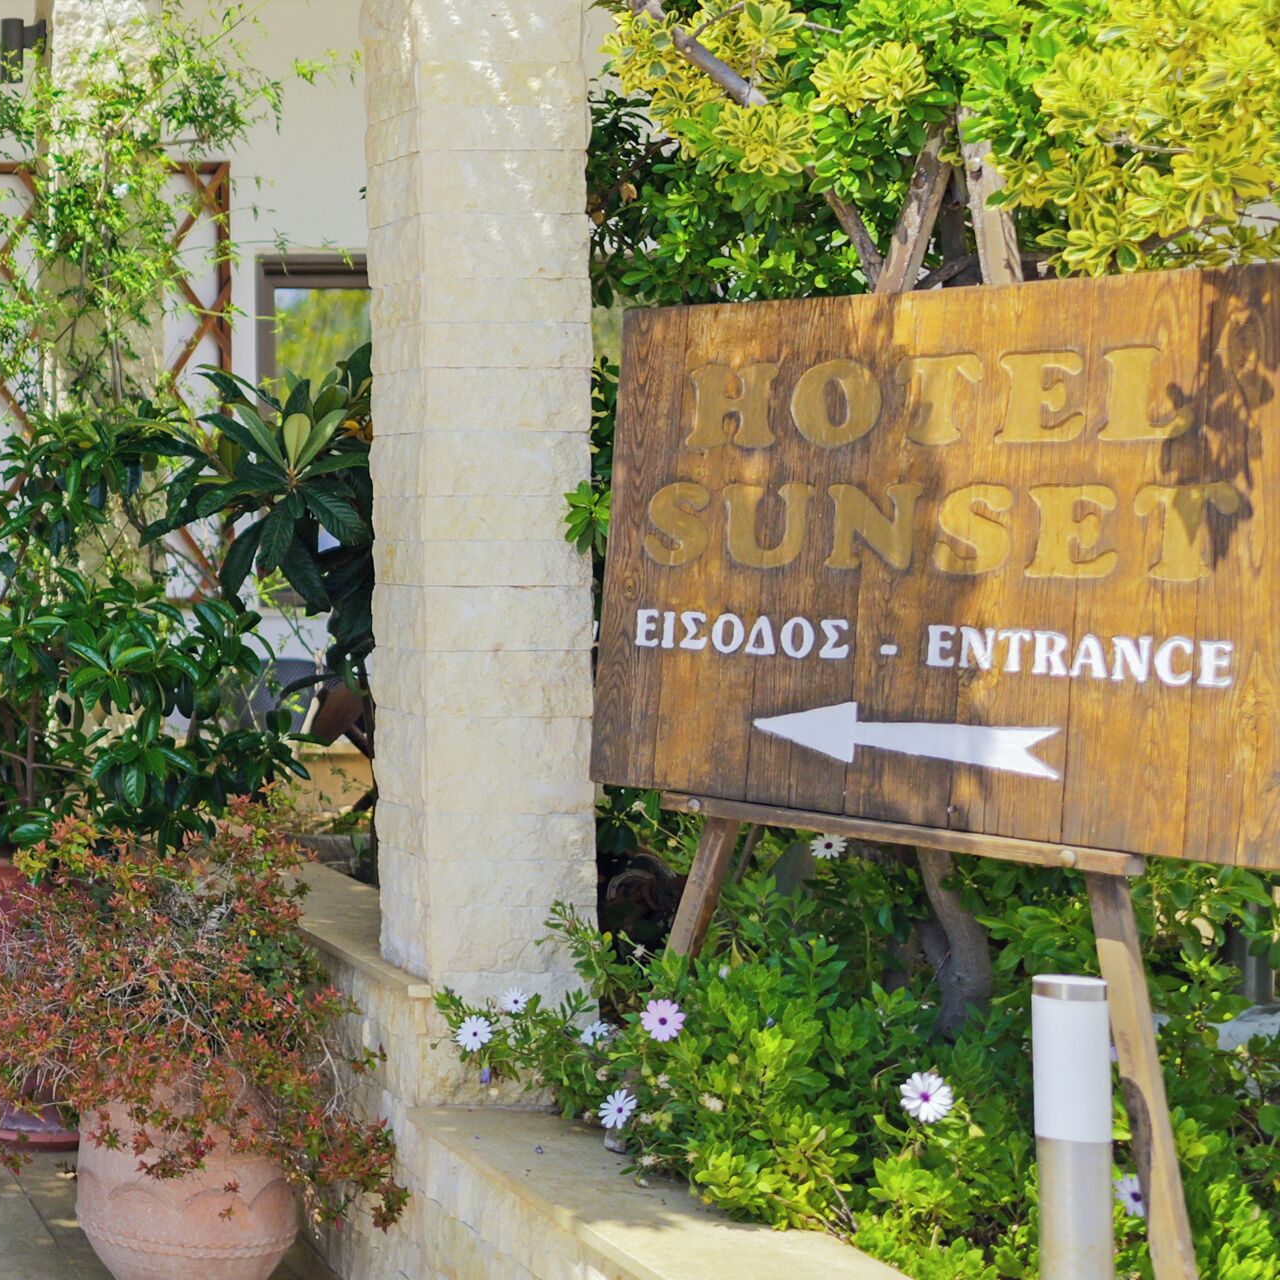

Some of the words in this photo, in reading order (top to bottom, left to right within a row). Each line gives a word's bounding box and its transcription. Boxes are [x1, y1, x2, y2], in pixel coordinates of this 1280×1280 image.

[684, 344, 1192, 449] HOTEL
[642, 480, 1241, 582] SUNSET
[633, 607, 850, 659] ΕΙΣΟΔΟΣ
[925, 623, 1234, 689] ENTRANCE
